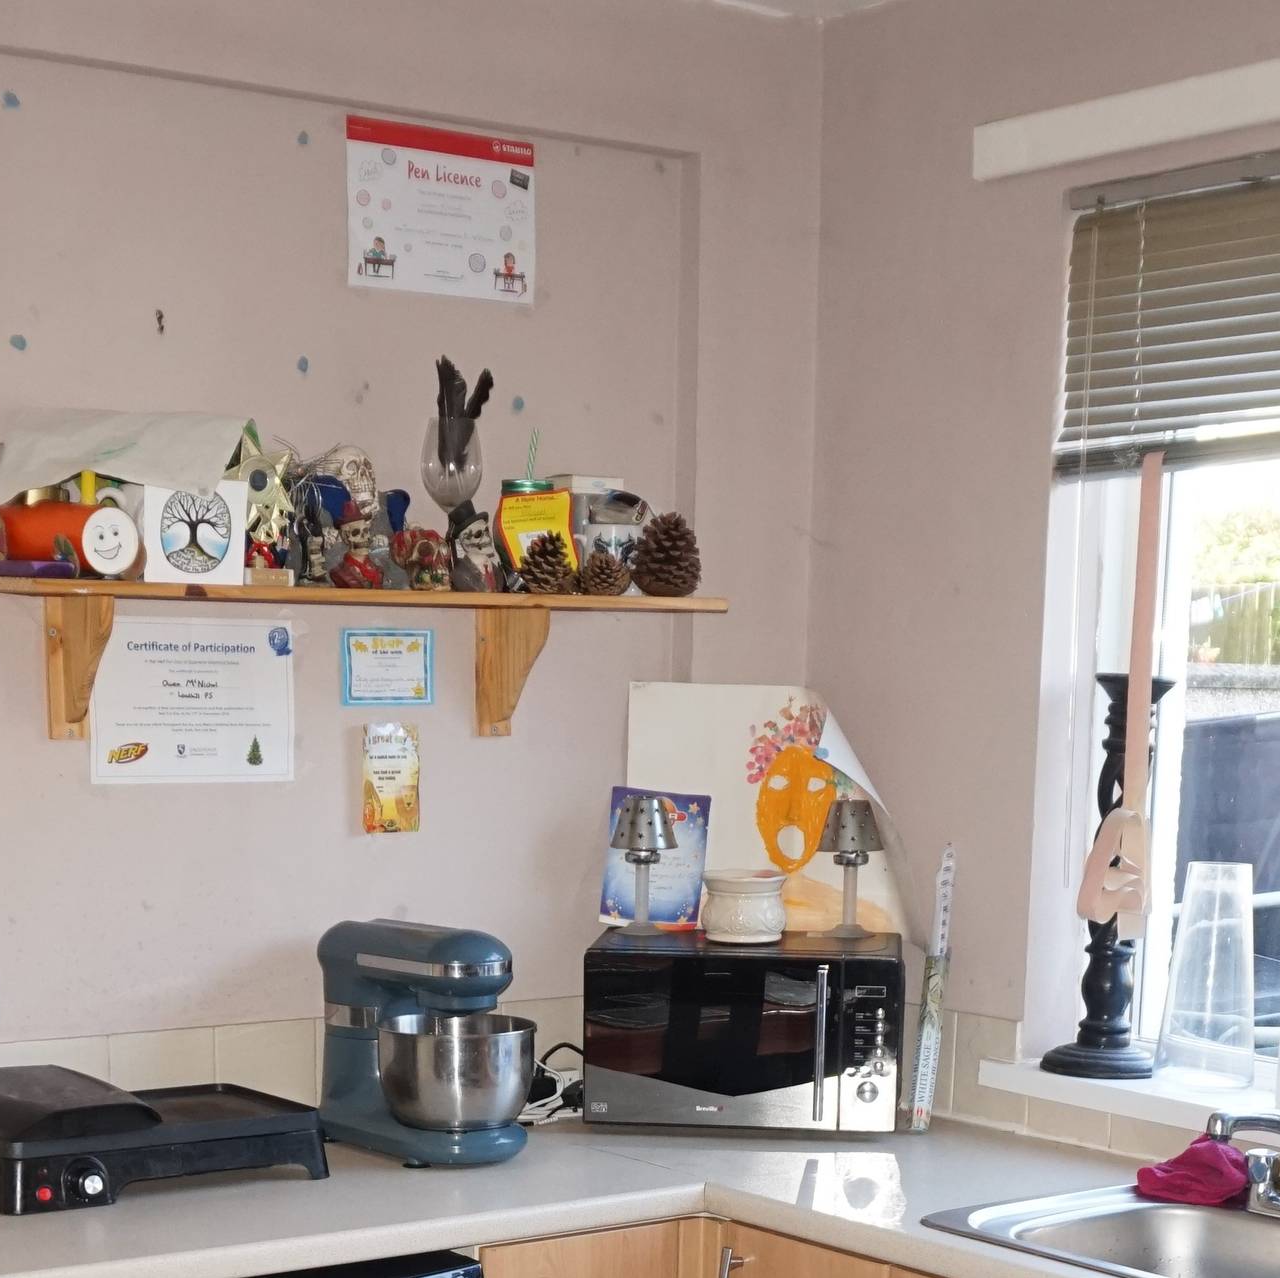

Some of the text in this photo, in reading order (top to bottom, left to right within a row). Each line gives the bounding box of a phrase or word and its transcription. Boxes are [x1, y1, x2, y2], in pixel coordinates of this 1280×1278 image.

[407, 160, 482, 188] Pen Licence
[126, 641, 256, 655] Certificate of Participation
[107, 743, 147, 764] NERF
[917, 1044, 932, 1104] WHITE SAGE
